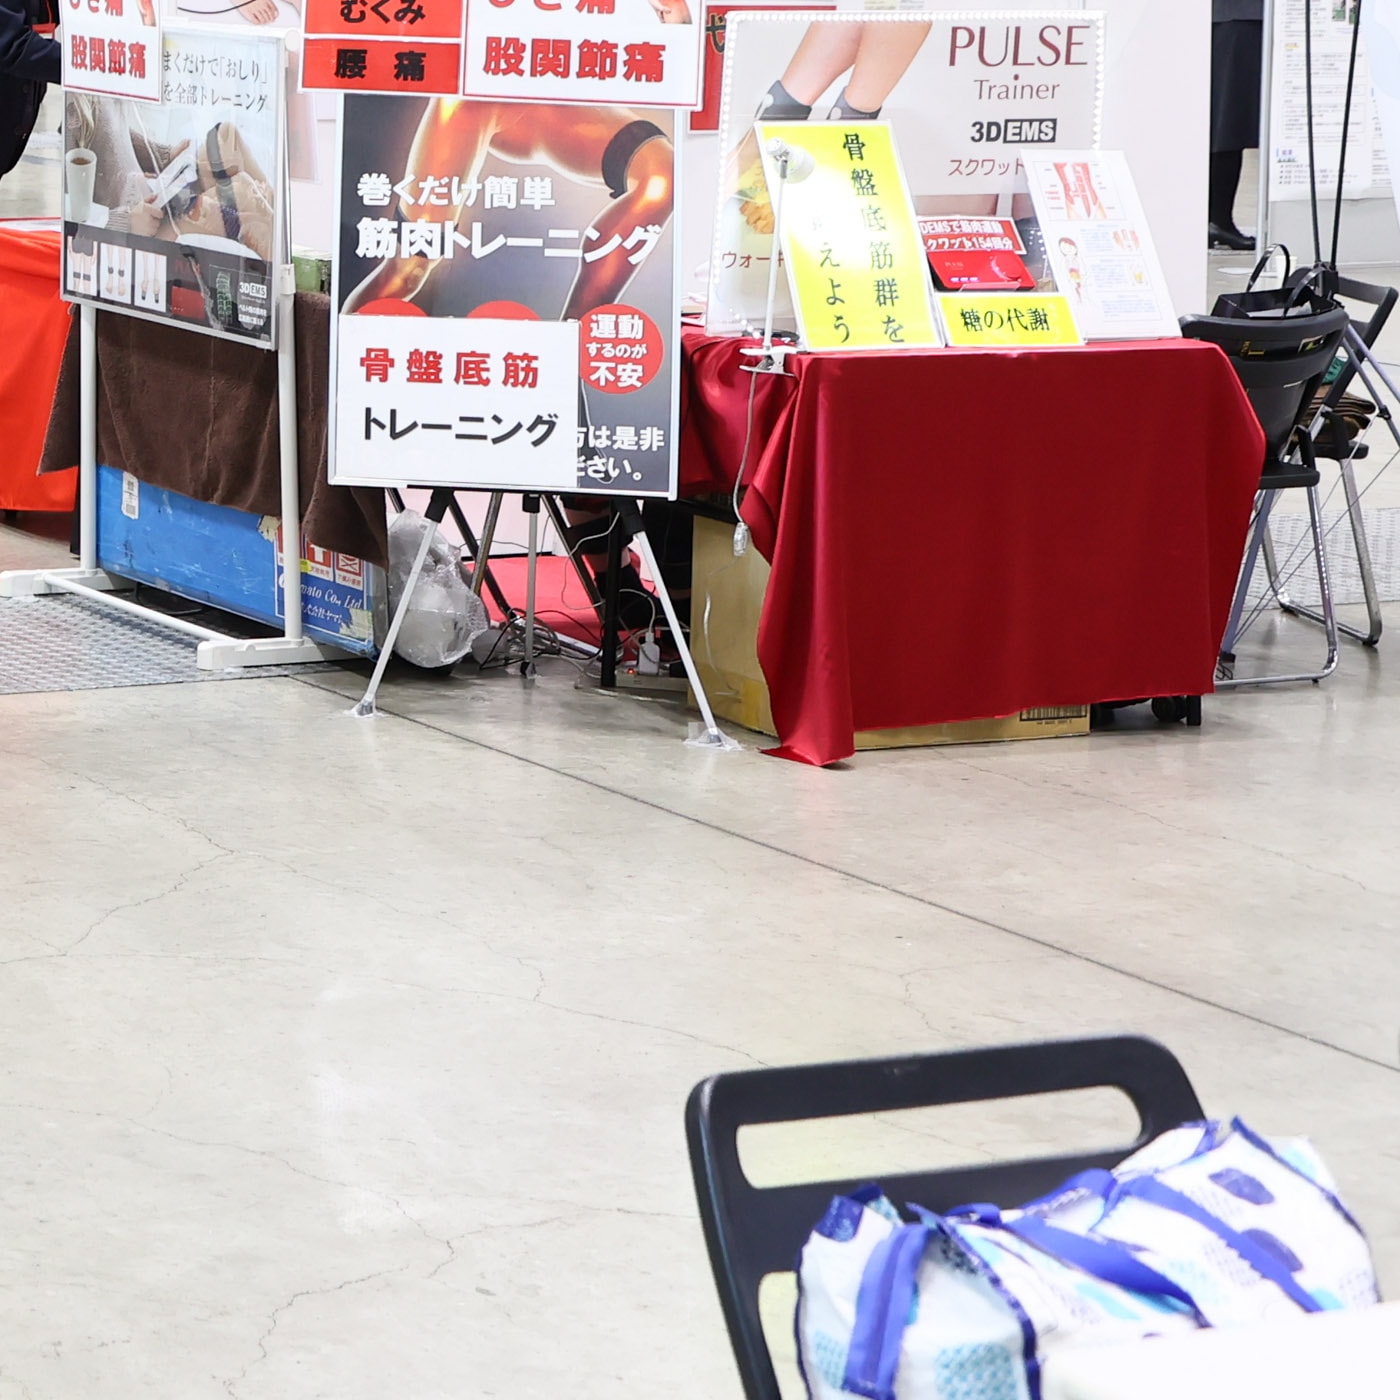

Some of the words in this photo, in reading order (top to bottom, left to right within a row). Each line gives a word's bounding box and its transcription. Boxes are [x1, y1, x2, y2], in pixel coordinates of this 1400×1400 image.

[71, 34, 147, 80] 股関節痛
[483, 36, 667, 83] 股関節痛
[948, 24, 1092, 68] PULSE
[163, 50, 268, 84] まくだけで「おしり」
[163, 81, 268, 113] を全部トレーニング
[973, 74, 1061, 101] Trainer
[355, 172, 556, 210] 巻くだけ簡単
[354, 216, 663, 266] 筋肉トレーニング
[841, 131, 906, 344] 骨盤底筋群を
[590, 313, 644, 340] 運動
[960, 307, 1050, 333] 糖の代謝
[359, 347, 540, 389] 骨盤底筋
[585, 341, 648, 360] するのが
[589, 361, 644, 388] 不安
[362, 406, 560, 448] トレーニング
